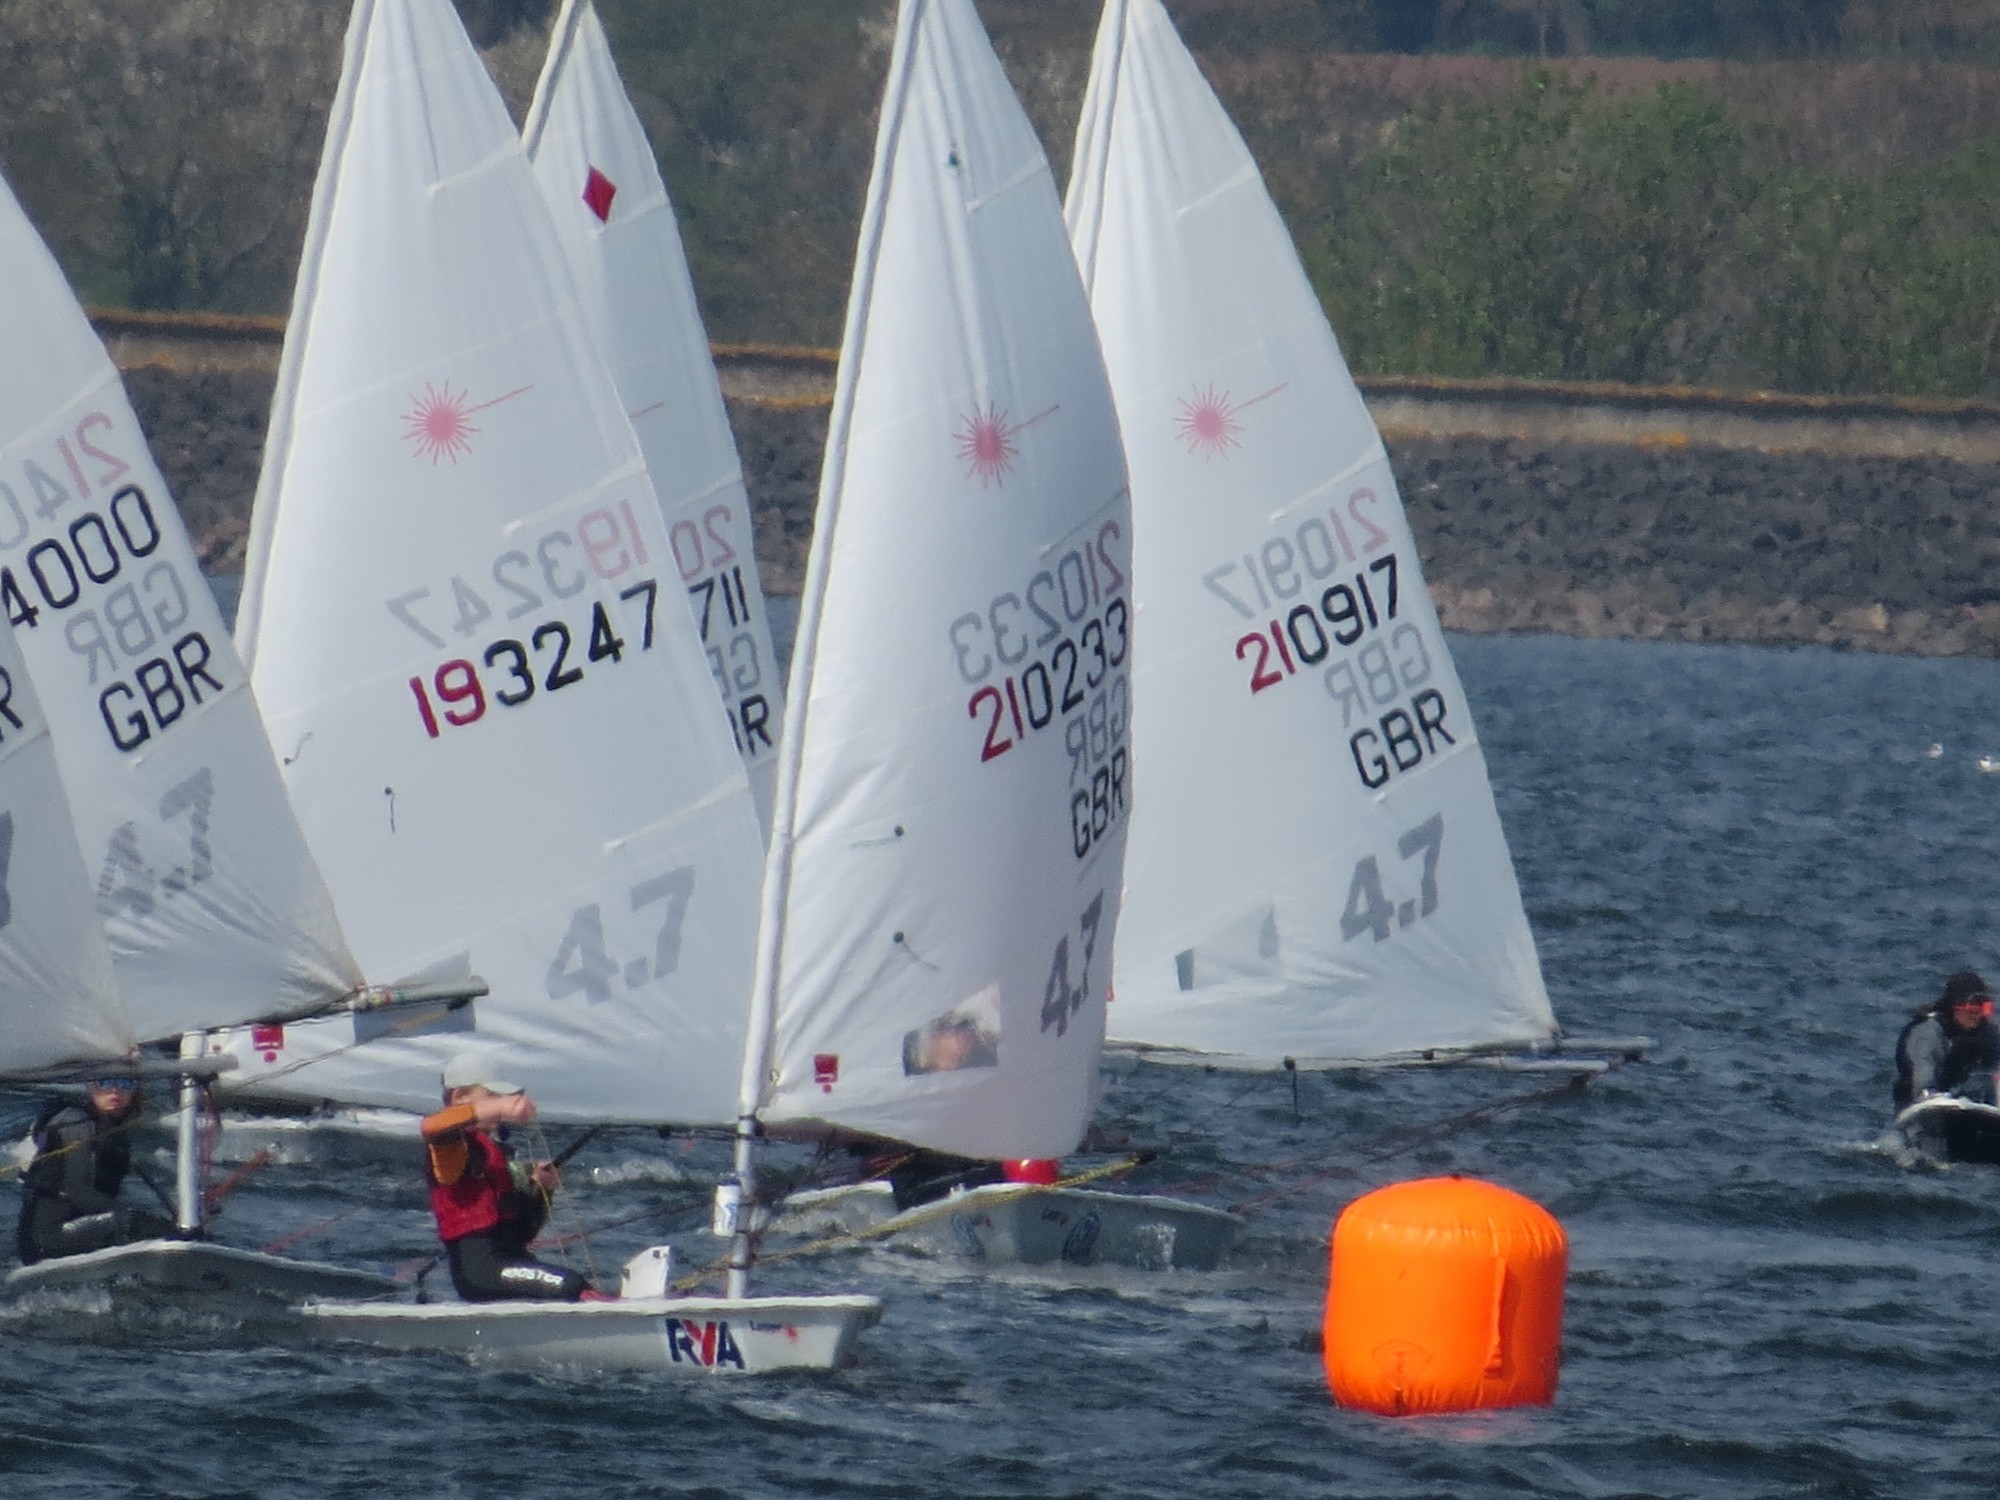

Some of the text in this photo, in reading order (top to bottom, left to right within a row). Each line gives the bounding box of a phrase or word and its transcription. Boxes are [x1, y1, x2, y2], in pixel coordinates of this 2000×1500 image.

[0, 484, 160, 628] 4000
[1235, 553, 1399, 694] 210917
[98, 631, 223, 752] GBR
[409, 578, 657, 738] 193247
[969, 597, 1127, 762] 210233
[1072, 746, 1125, 859] GBR
[1350, 688, 1456, 789] GBR
[97, 767, 214, 915] 4.7
[1340, 812, 1445, 943] 4.7
[545, 864, 696, 1006] 4.7
[1041, 888, 1104, 1038] 4.7
[665, 1317, 746, 1370] RYA
